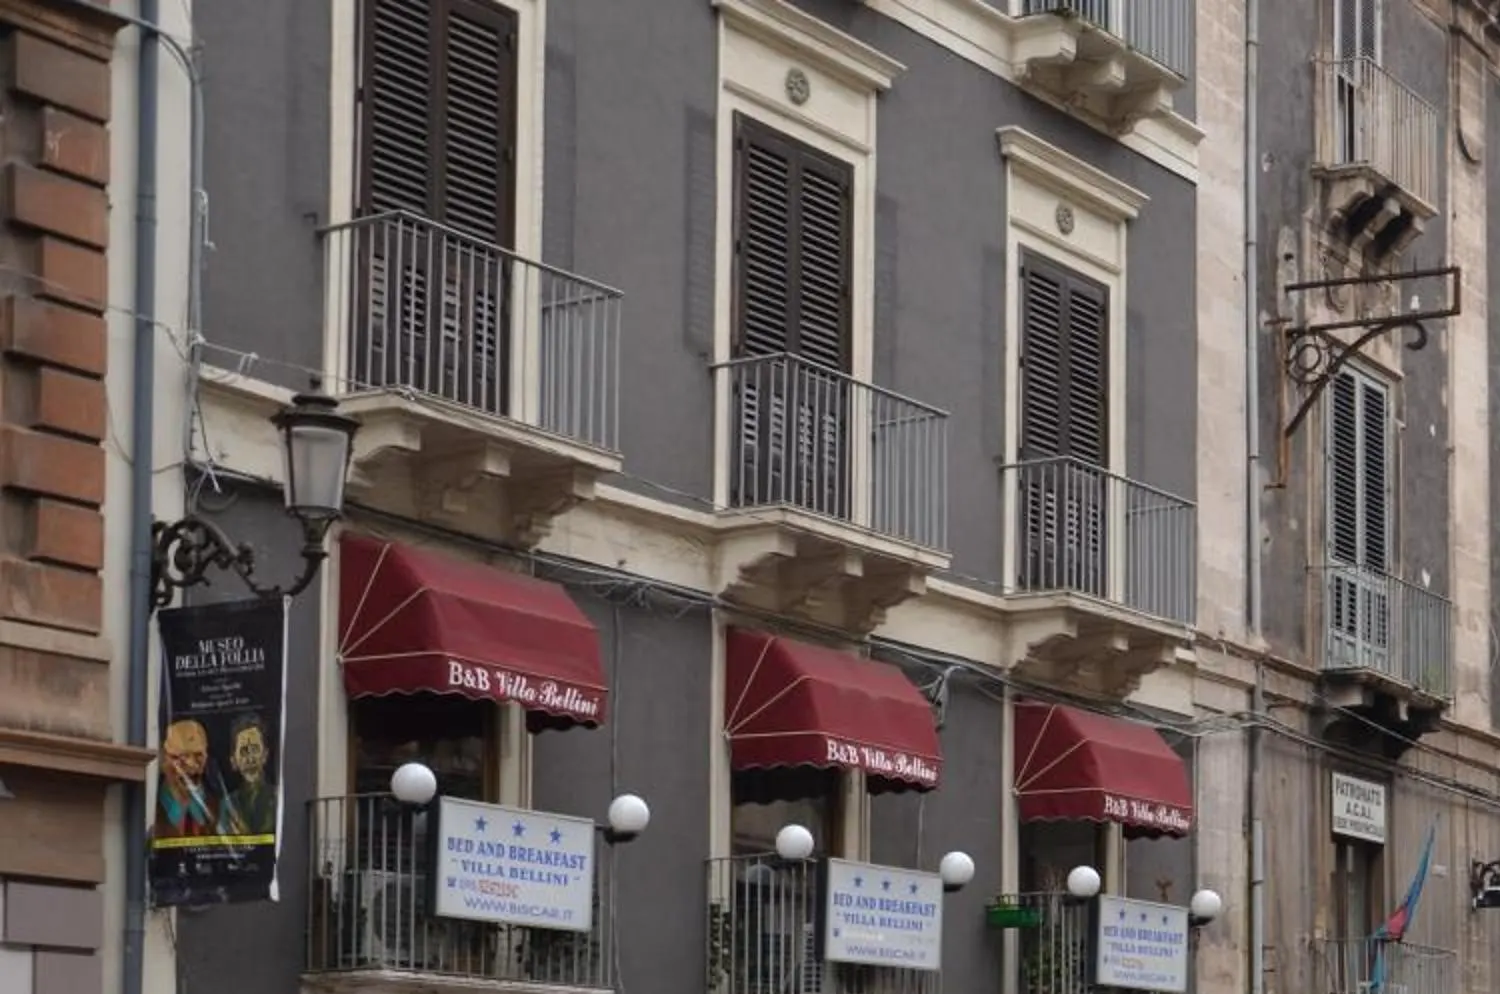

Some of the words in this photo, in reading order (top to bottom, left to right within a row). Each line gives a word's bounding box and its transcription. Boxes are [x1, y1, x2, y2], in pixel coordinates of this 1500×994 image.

[198, 636, 245, 654] MUSEO
[175, 652, 217, 670] DELLA
[448, 660, 491, 691] B&B
[495, 671, 538, 700] Villa
[539, 680, 599, 715] Bellini
[826, 739, 859, 765] B&B
[861, 747, 892, 771] Villa
[894, 753, 937, 782] Bellini
[1103, 794, 1129, 817] B&B
[447, 837, 474, 853] BED
[477, 840, 505, 857] AND
[508, 845, 587, 871] BREAKFAST
[461, 859, 505, 877] VILLA
[509, 867, 569, 888] BELLINI
[833, 891, 853, 907] BED
[856, 895, 877, 910] AND
[878, 898, 937, 917] BREAKFAST
